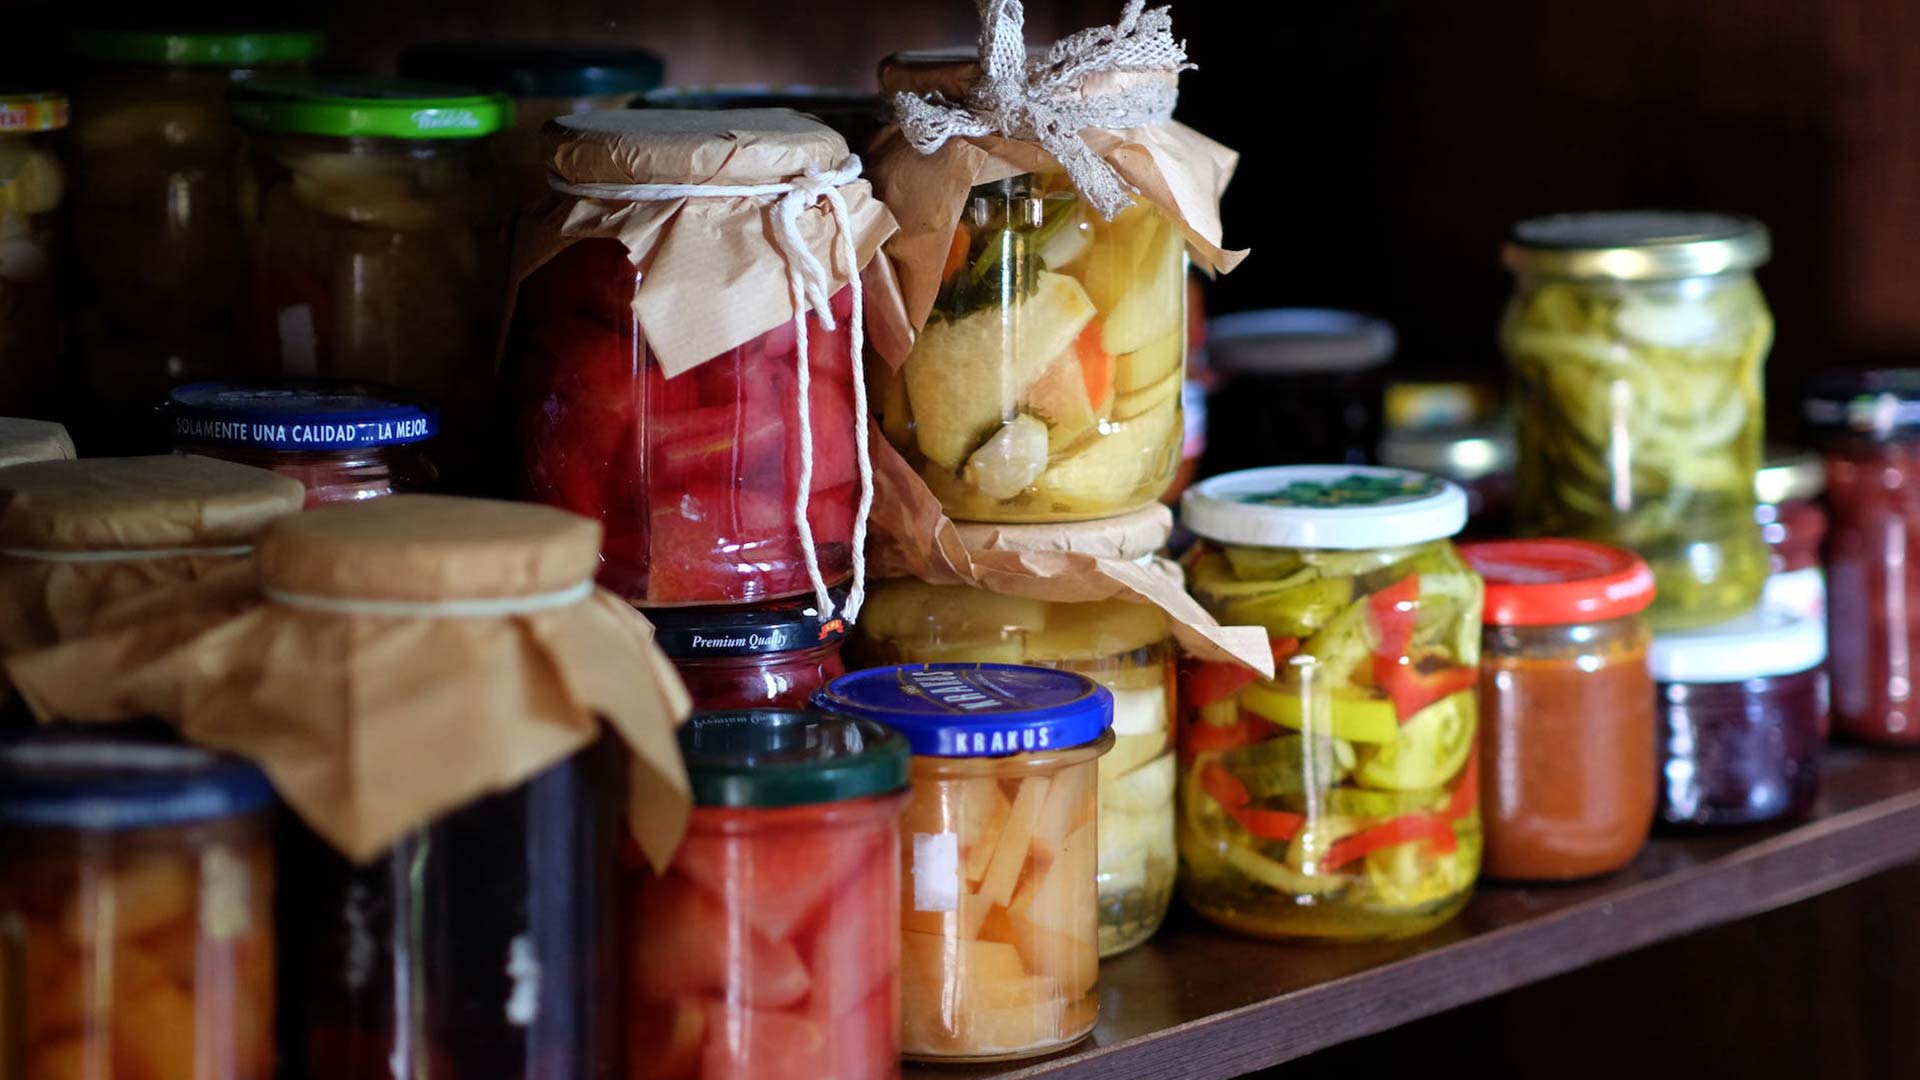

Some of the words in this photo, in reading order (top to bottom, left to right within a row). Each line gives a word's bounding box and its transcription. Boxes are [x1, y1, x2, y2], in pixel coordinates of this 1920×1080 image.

[176, 416, 247, 441] SOLAMENTE
[252, 424, 287, 442] UNA
[292, 425, 356, 443] CALIDAD
[378, 423, 393, 441] LA
[396, 417, 429, 439] MEJOR.
[692, 635, 746, 648] Premium
[749, 629, 787, 650] Quality
[911, 669, 1003, 711] KRAKUS
[955, 726, 1050, 753] KRAKUS
